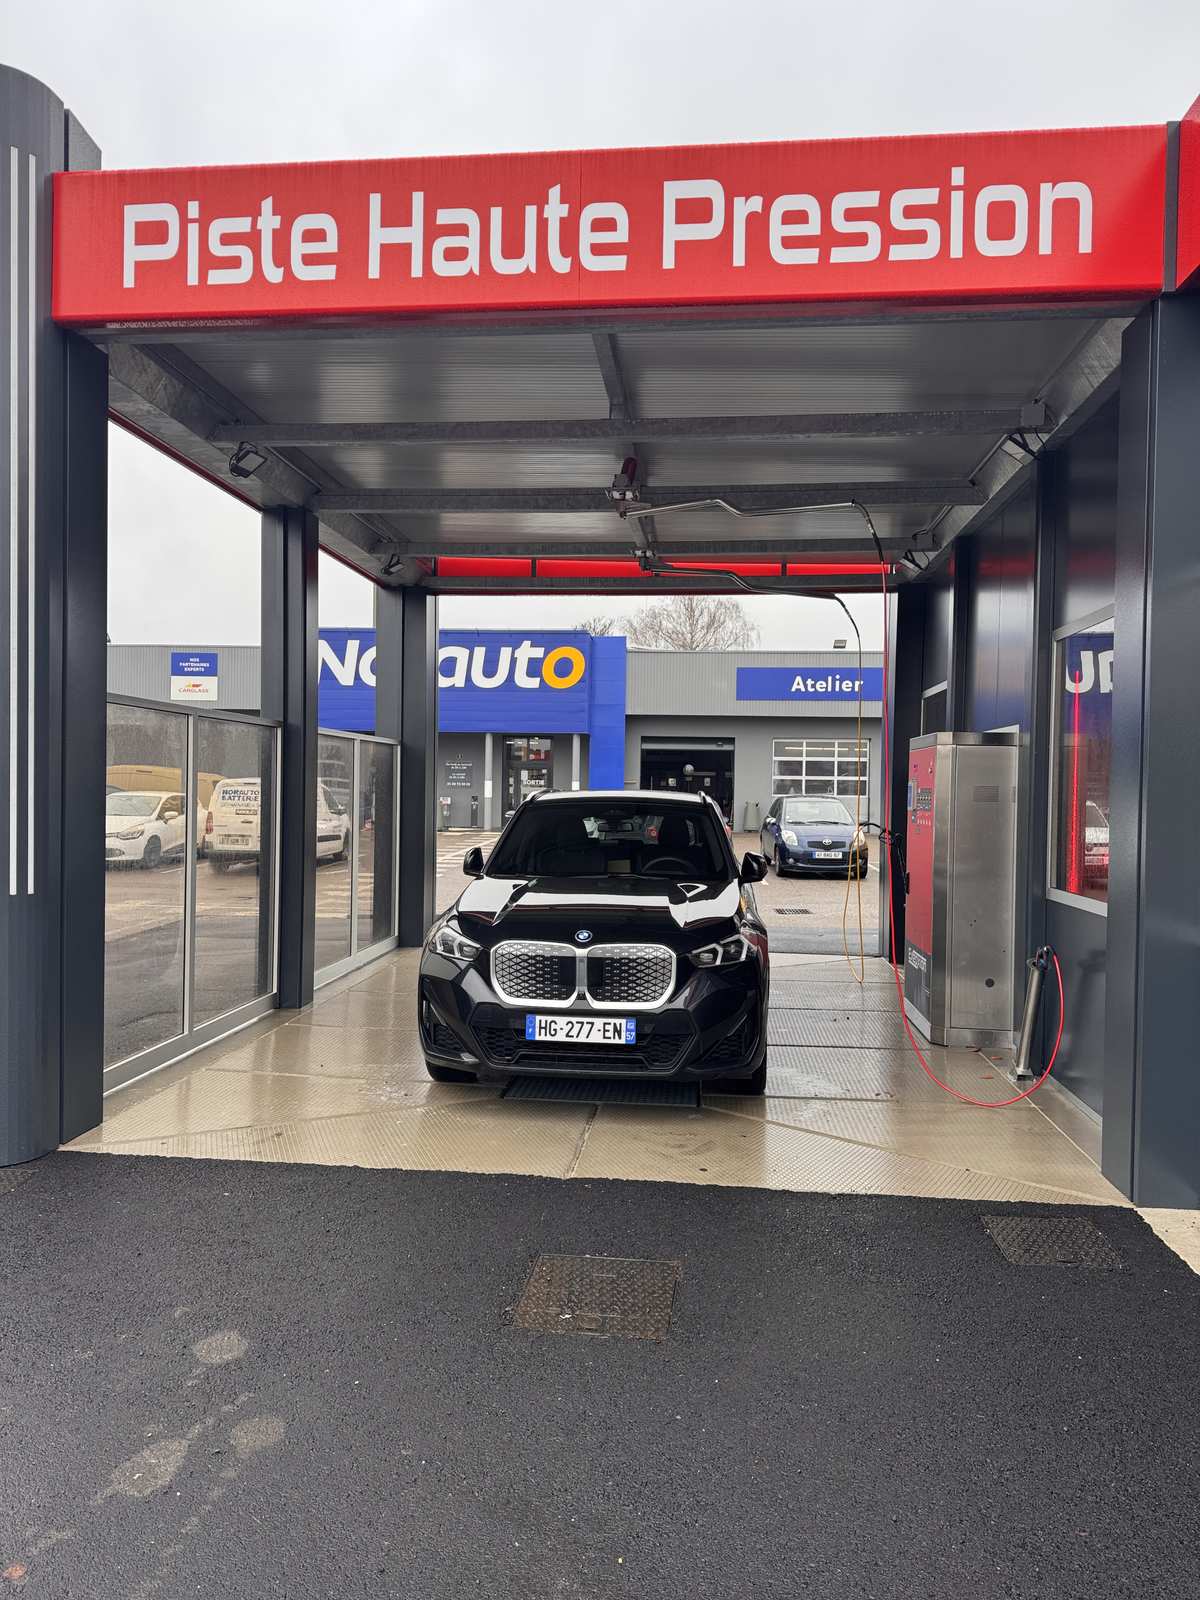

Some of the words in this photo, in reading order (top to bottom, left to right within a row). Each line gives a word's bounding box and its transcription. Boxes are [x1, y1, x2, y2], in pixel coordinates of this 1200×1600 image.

[122, 194, 338, 289] Piste
[367, 183, 629, 279] Haute
[662, 166, 1093, 270] Pression
[790, 674, 864, 693] Atelier
[538, 1019, 622, 1041] HG-277-EN
